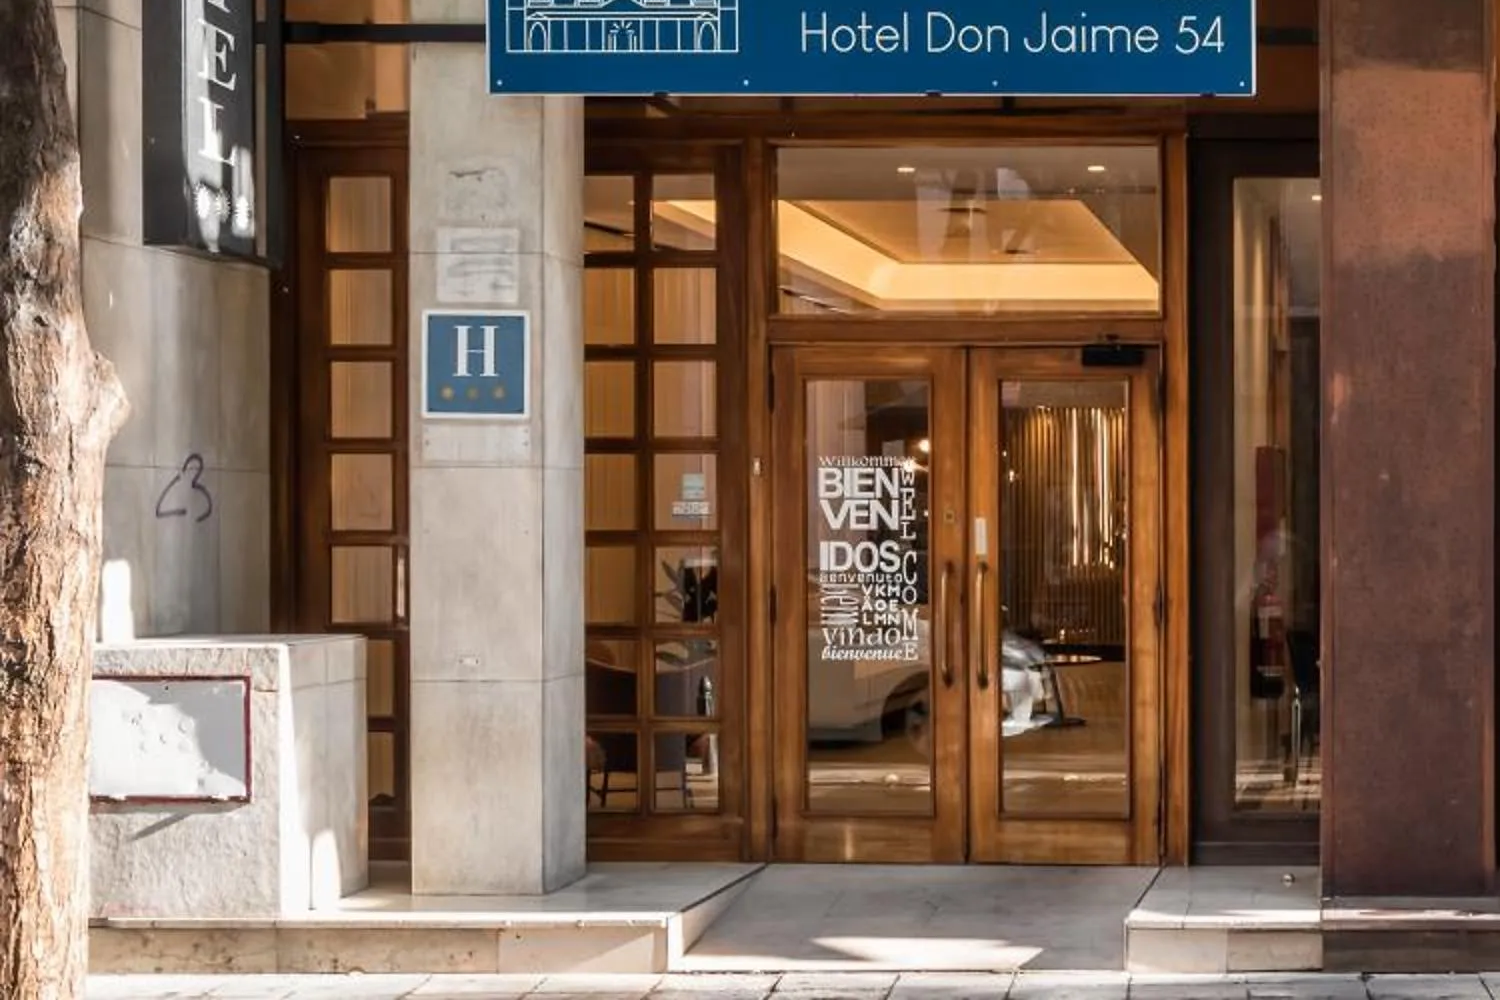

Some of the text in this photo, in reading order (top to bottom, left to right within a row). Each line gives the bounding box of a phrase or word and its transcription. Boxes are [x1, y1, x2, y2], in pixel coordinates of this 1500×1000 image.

[800, 11, 1225, 55] Hotel Don Jaime 54
[453, 325, 499, 377] H
